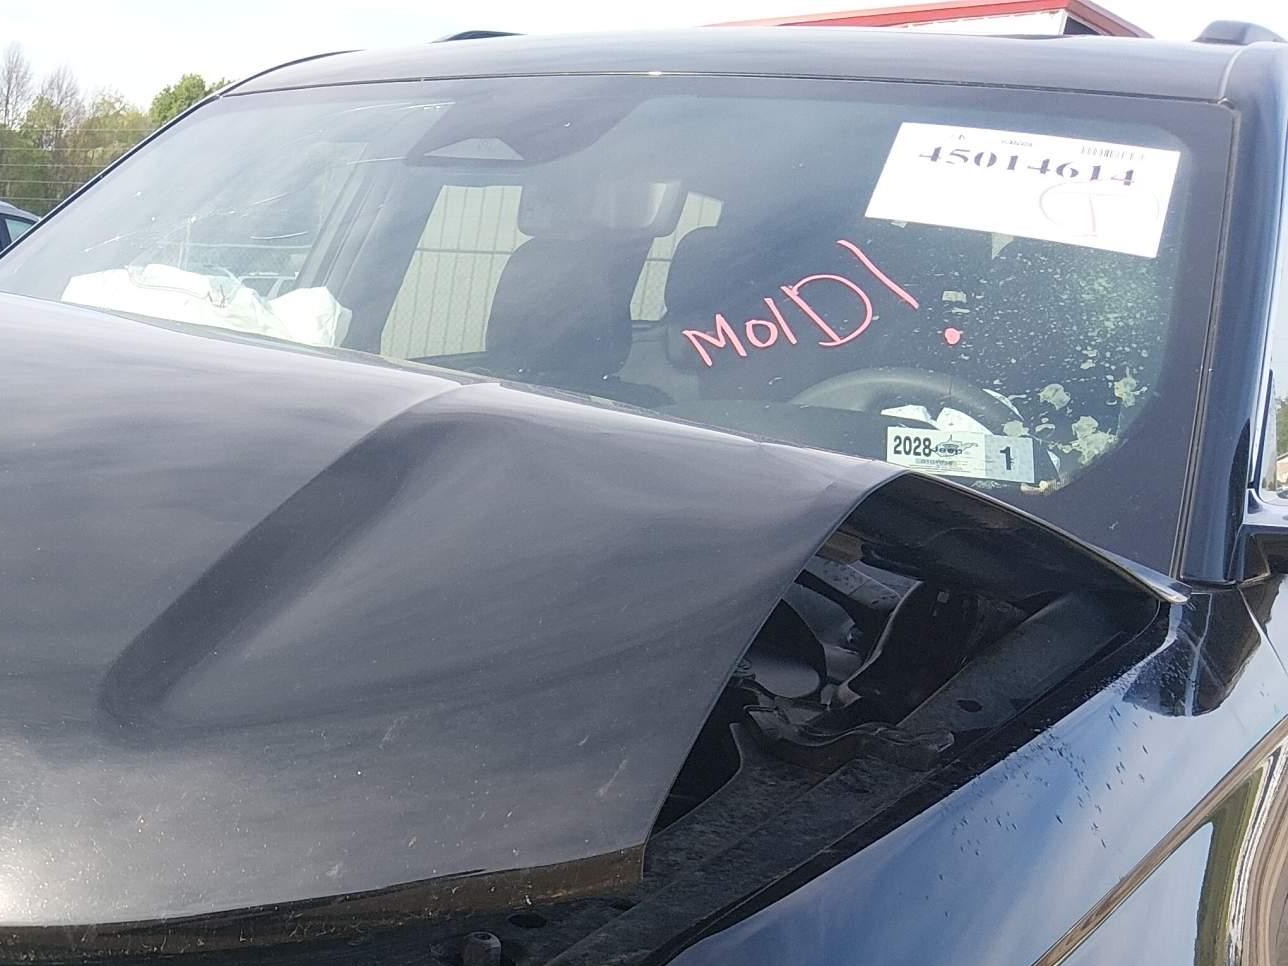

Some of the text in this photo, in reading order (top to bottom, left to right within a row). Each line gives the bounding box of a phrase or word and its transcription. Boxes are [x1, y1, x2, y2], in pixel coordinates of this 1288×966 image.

[919, 145, 1135, 187] 45014614
[893, 434, 932, 457] 2028
[999, 446, 1013, 471] 1
